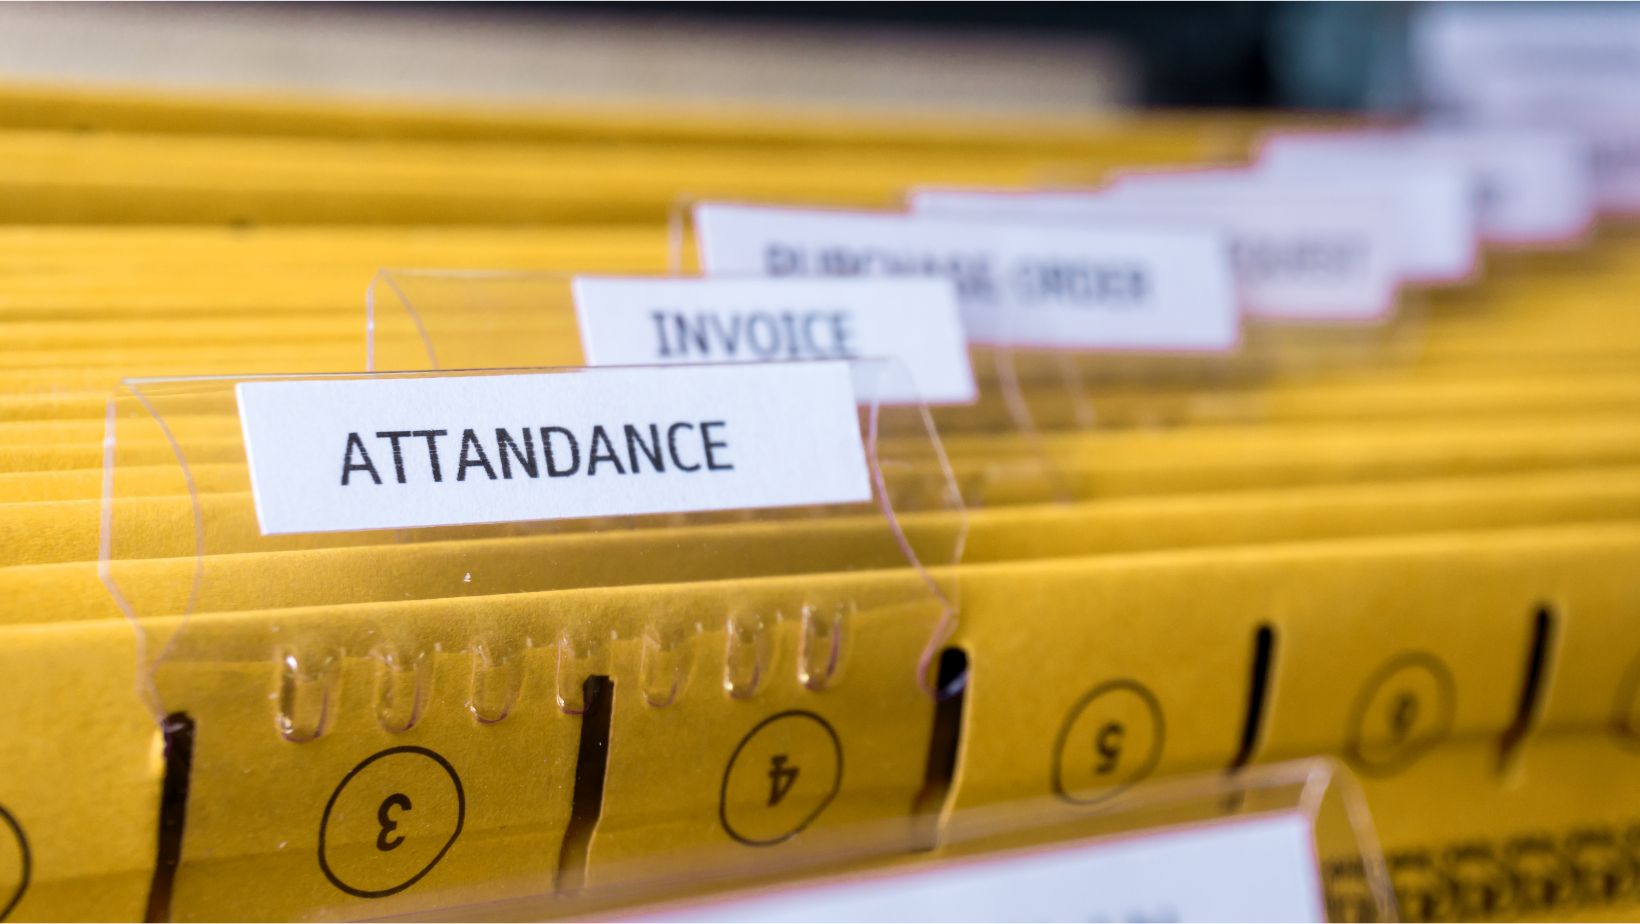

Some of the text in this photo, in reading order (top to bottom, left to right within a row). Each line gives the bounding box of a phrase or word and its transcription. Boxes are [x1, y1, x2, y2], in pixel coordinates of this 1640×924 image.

[652, 309, 856, 358] INVOICE
[341, 420, 734, 486] ATTANDANCE
[1094, 722, 1124, 775] 5
[767, 754, 799, 807] 4
[377, 793, 412, 851] 3
